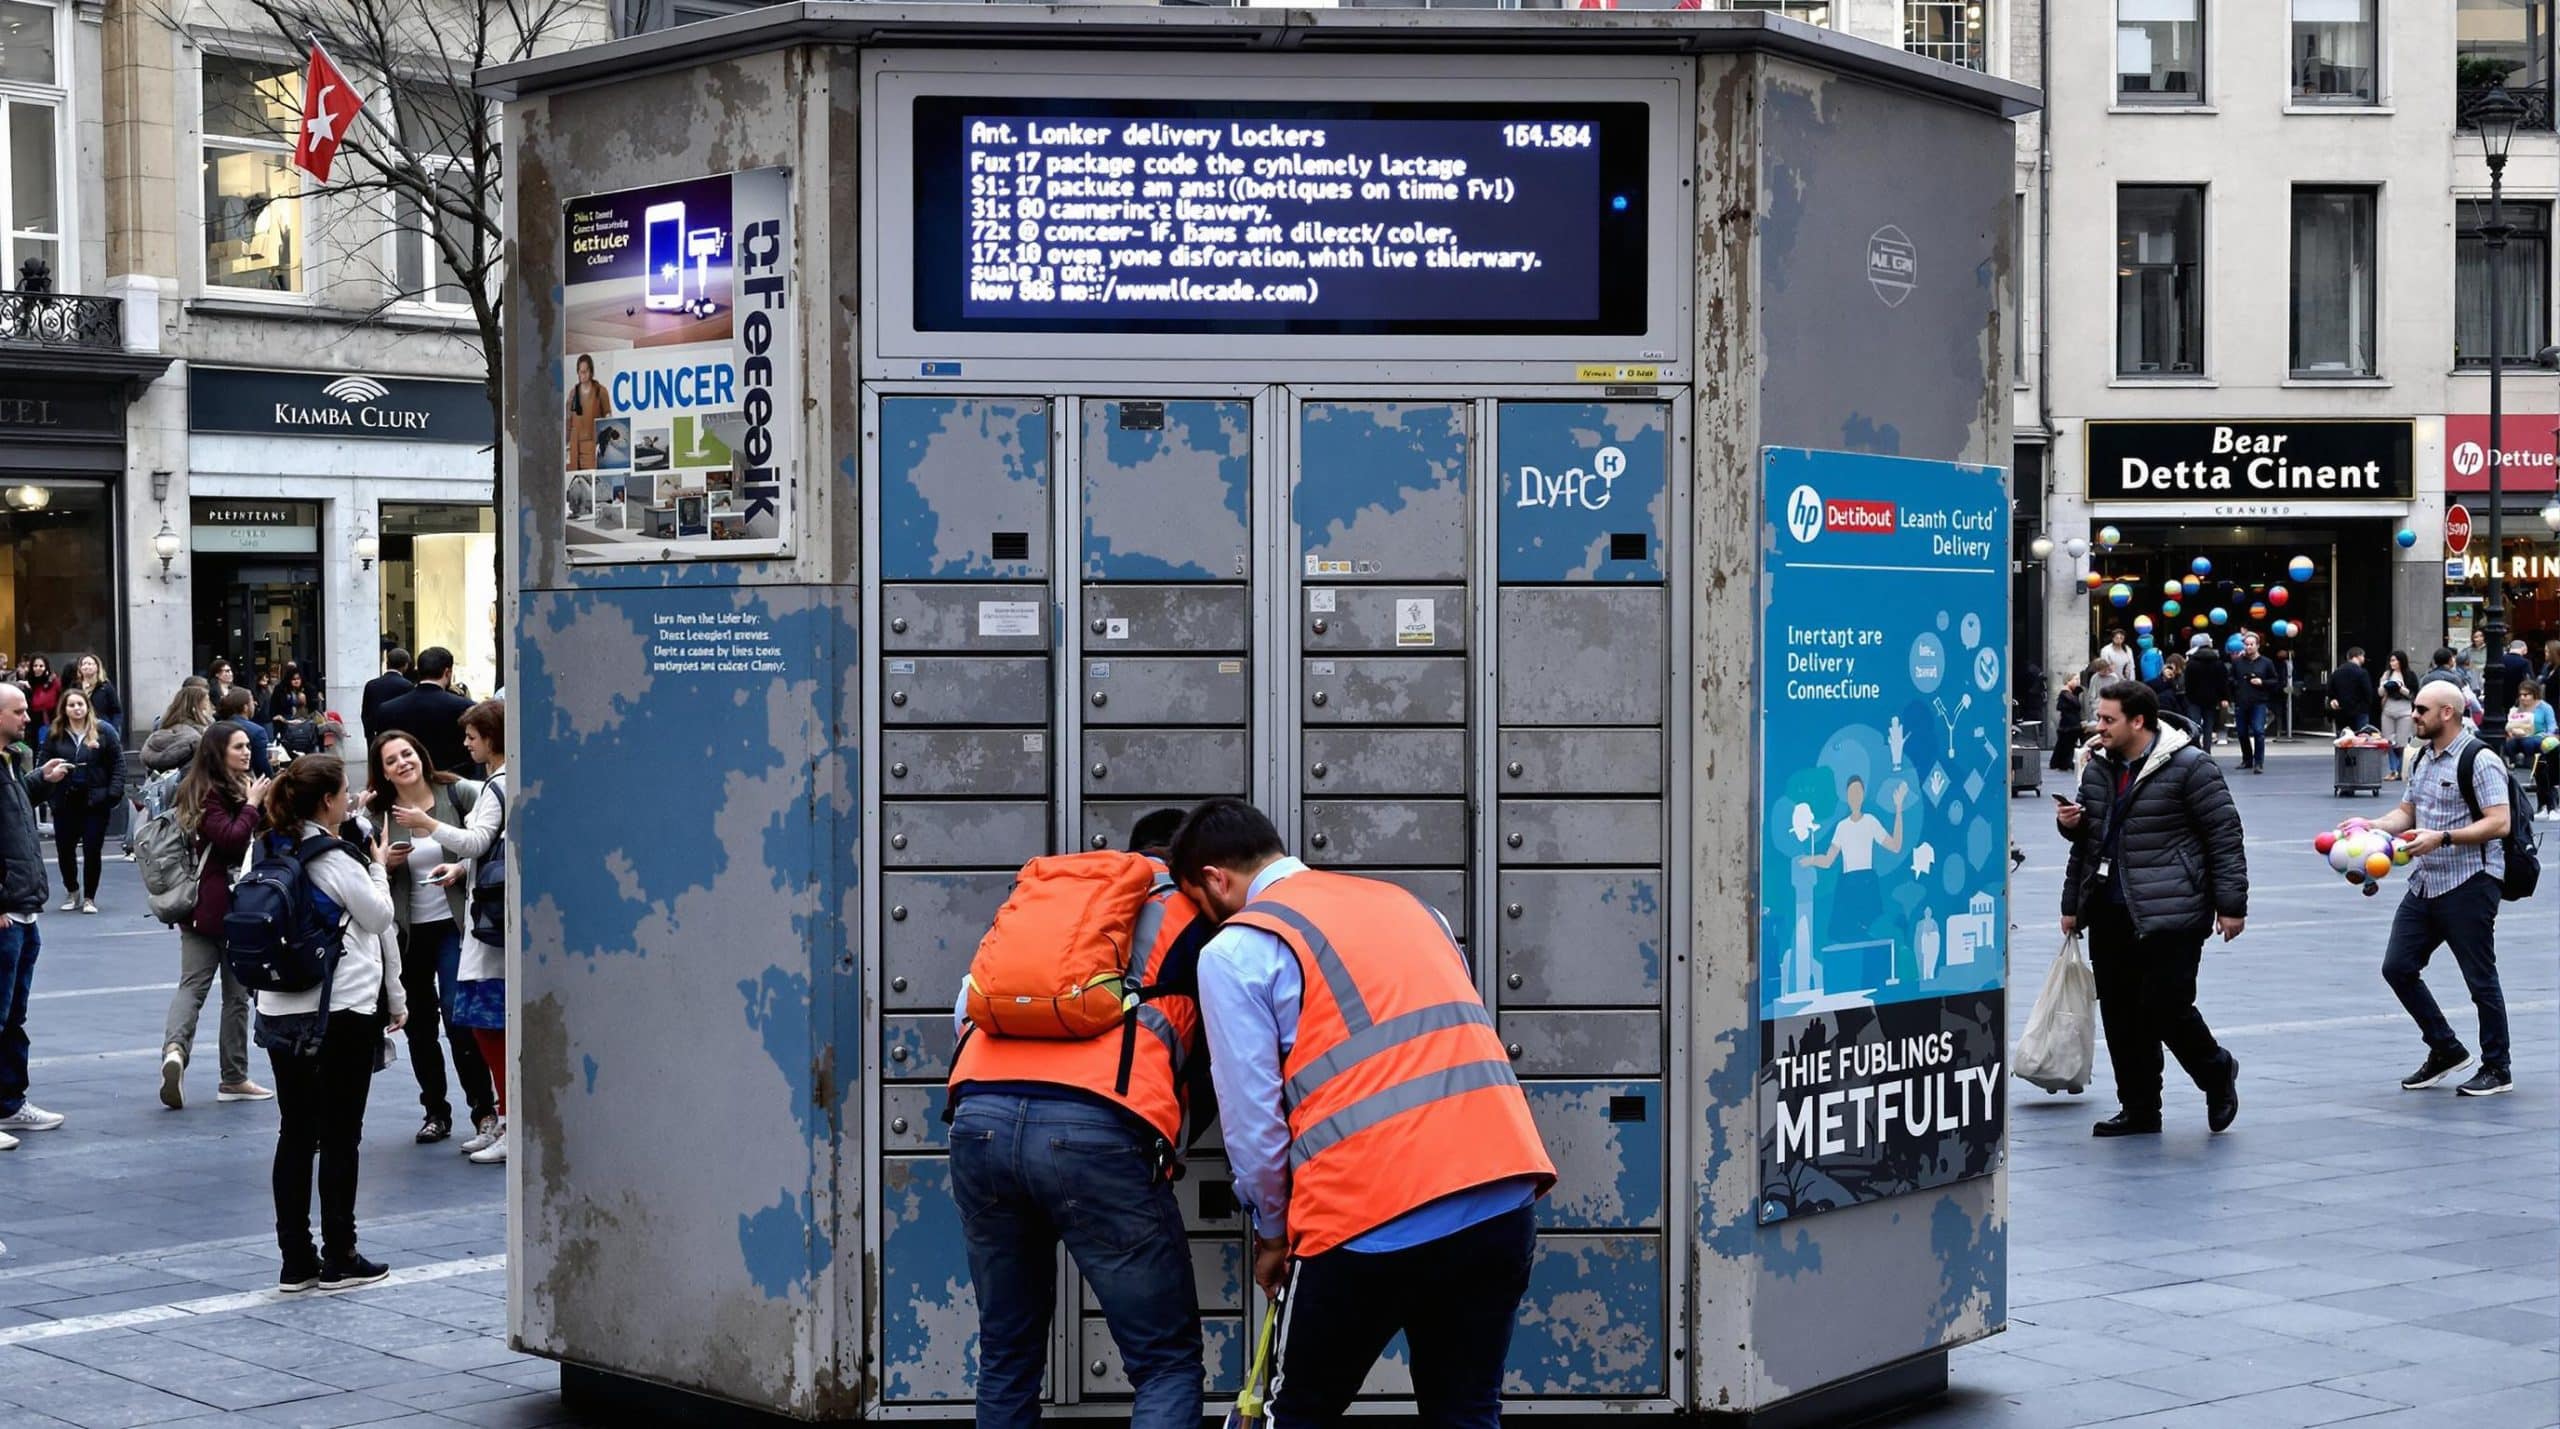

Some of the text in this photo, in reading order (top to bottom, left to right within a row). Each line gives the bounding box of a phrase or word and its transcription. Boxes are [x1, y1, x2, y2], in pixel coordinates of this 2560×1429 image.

[971, 121, 1018, 145] Ant.
[1028, 122, 1112, 146] Lonker
[1122, 123, 1222, 150] delivery
[1015, 152, 1042, 173] 17
[1046, 152, 1136, 178] package
[1143, 152, 1199, 175] code
[1206, 153, 1246, 175] the
[1015, 175, 1042, 196] 17
[1360, 181, 1391, 199] on
[971, 219, 1011, 241] 72x
[971, 242, 1011, 264] 17x
[1372, 246, 1418, 268] live
[612, 363, 735, 413] CUNCER
[2212, 426, 2288, 454] Bear
[2247, 455, 2381, 490] Cinent
[1900, 507, 1948, 530] Leanth
[1933, 534, 1991, 560] Delivery
[1858, 630, 1883, 645] are
[1775, 1030, 1954, 1090] THIE FUBLINGS
[1776, 1062, 2001, 1165] METFULTY
